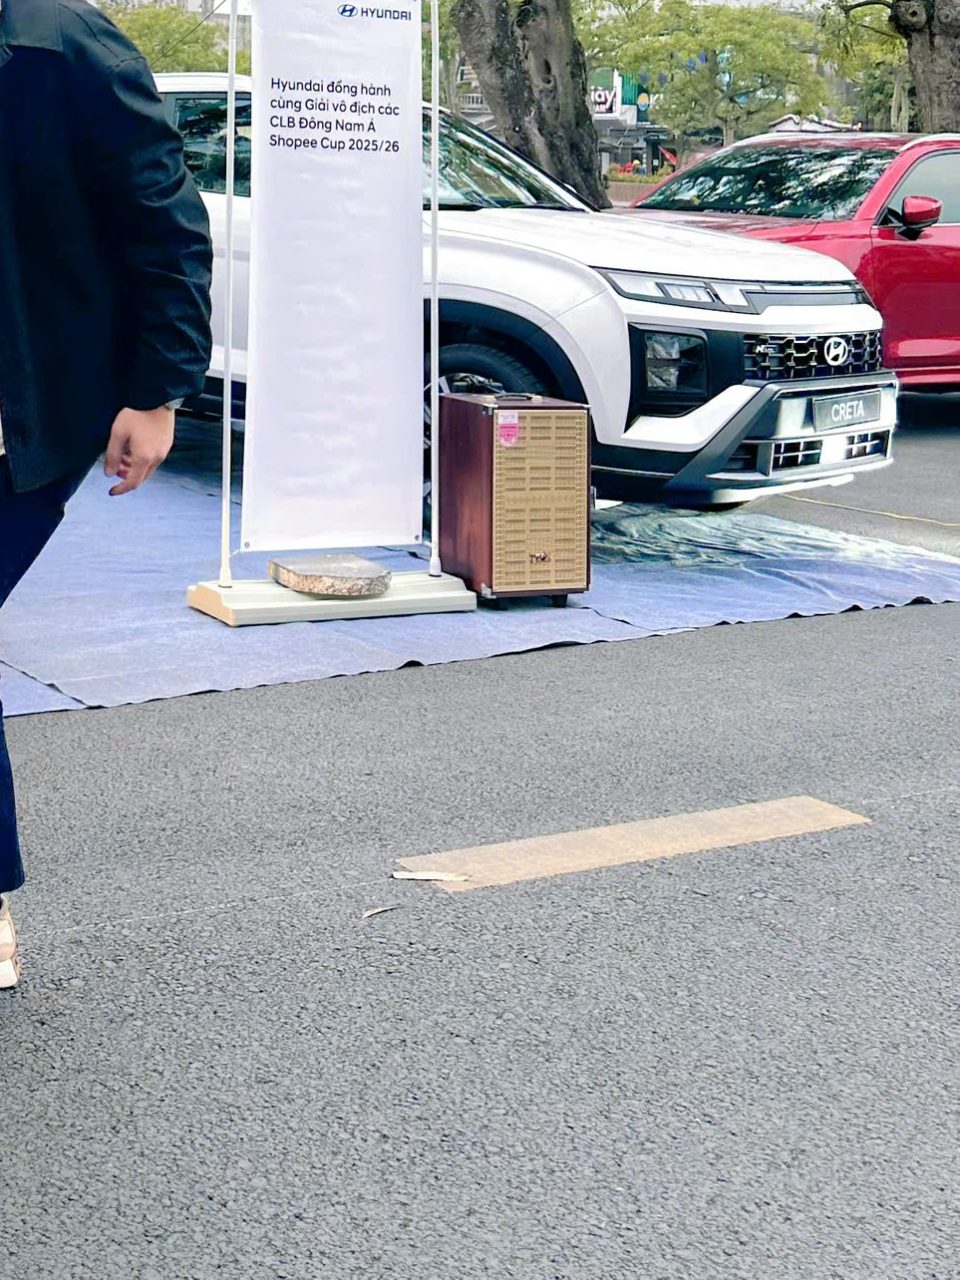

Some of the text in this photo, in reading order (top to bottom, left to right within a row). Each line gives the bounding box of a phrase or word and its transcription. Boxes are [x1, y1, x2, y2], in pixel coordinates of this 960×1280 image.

[361, 7, 411, 20] HYUNDAI
[271, 77, 324, 92] Hyundai
[361, 83, 391, 97] hành
[270, 96, 400, 116] cùng Giải vô địch các
[270, 115, 376, 133] CLB Đông Nam Á
[269, 134, 400, 153] Shopee Cup 2025/26
[831, 400, 865, 422] CRETA
